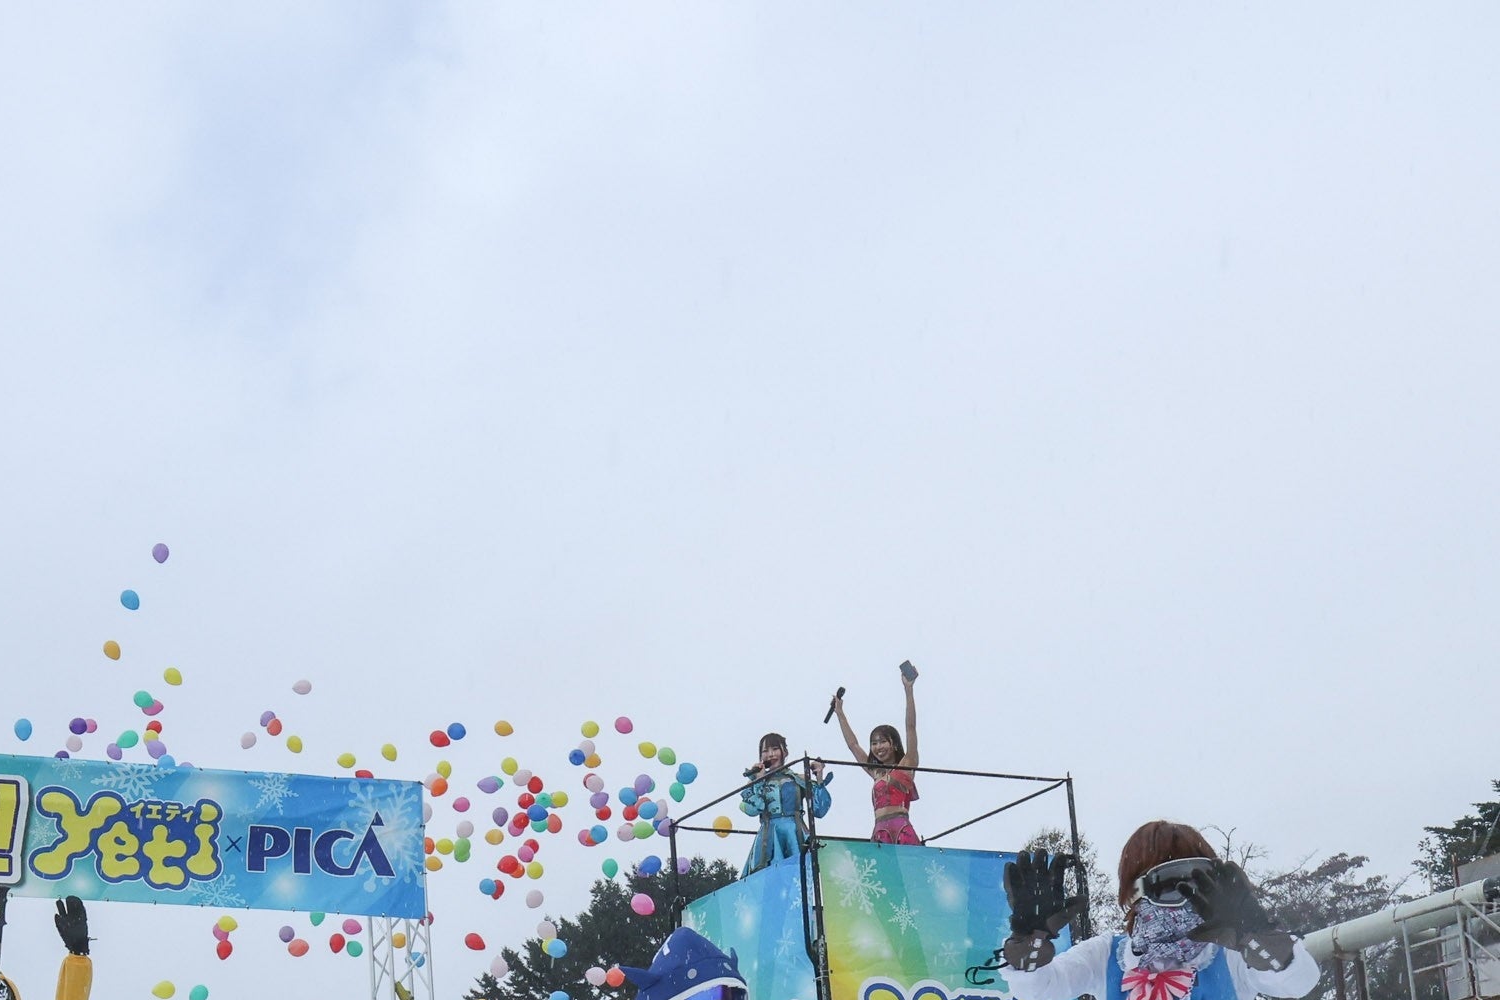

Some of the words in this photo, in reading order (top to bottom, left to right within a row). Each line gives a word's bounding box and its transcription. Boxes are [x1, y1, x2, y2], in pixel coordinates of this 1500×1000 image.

[31, 789, 220, 888] Yeti
[246, 811, 397, 877] PICA
[129, 802, 194, 823] イエティ
